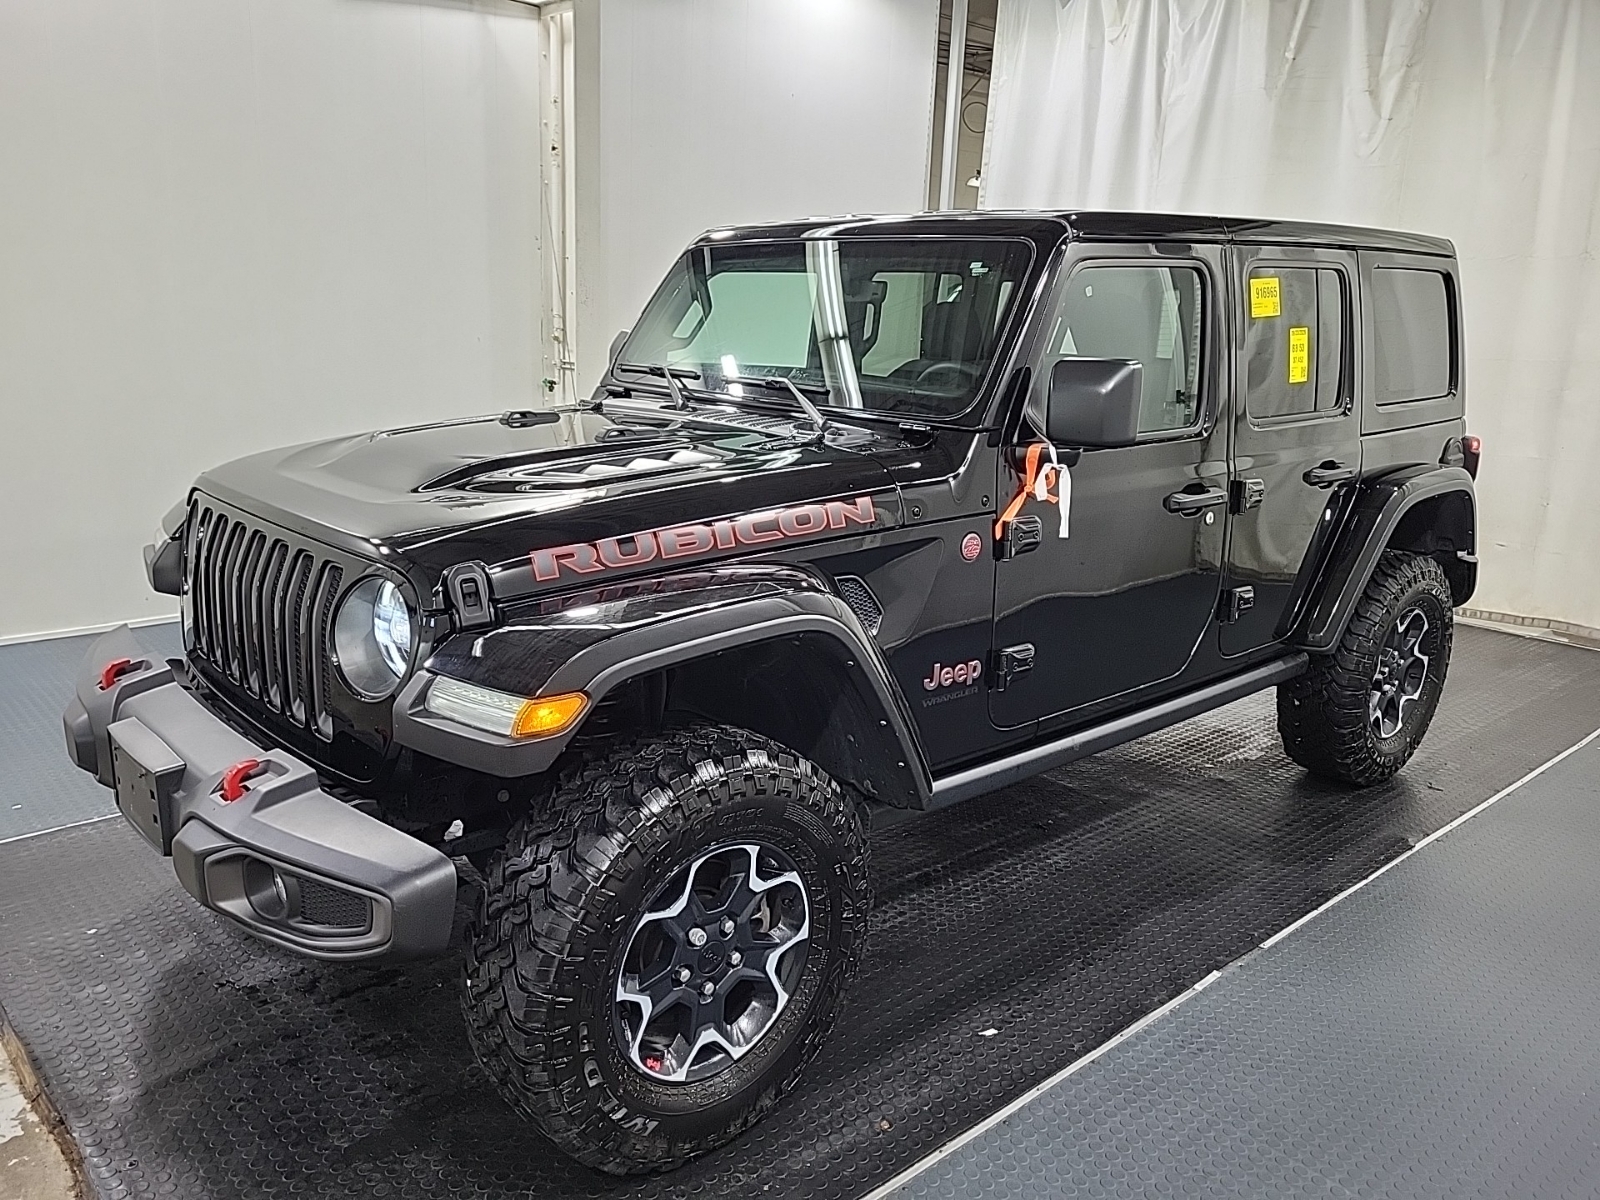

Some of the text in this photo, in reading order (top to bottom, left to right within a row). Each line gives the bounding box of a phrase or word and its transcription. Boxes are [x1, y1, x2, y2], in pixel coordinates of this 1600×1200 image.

[530, 496, 876, 582] RUBICON
[923, 660, 982, 690] Jeep
[922, 686, 979, 708] WRANGLER
